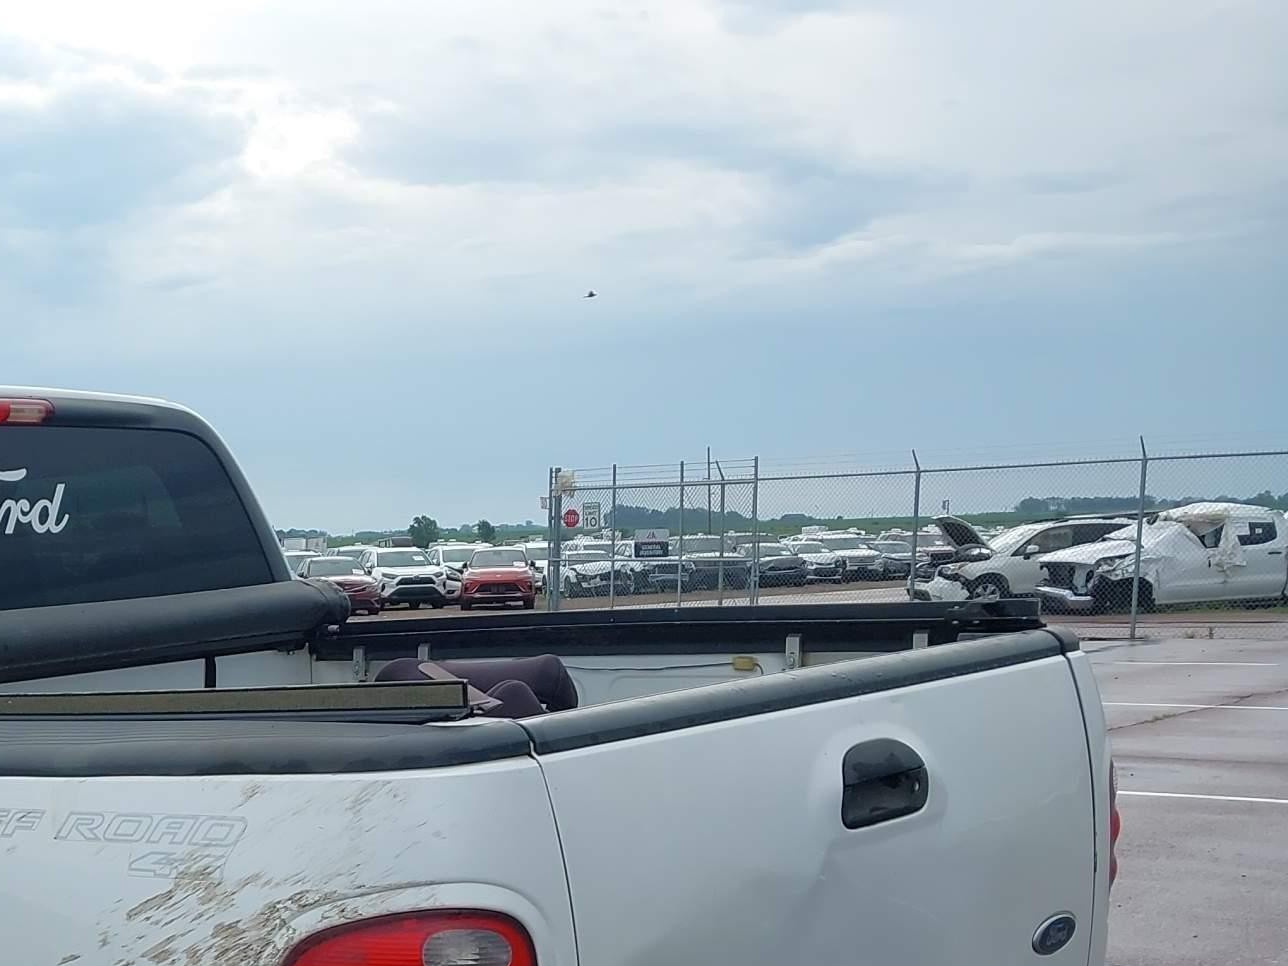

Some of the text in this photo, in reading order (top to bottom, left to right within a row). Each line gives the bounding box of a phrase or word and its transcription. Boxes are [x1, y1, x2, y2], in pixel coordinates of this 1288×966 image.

[564, 513, 578, 523] STOP
[585, 517, 597, 528] 10
[54, 811, 248, 848] ROAD
